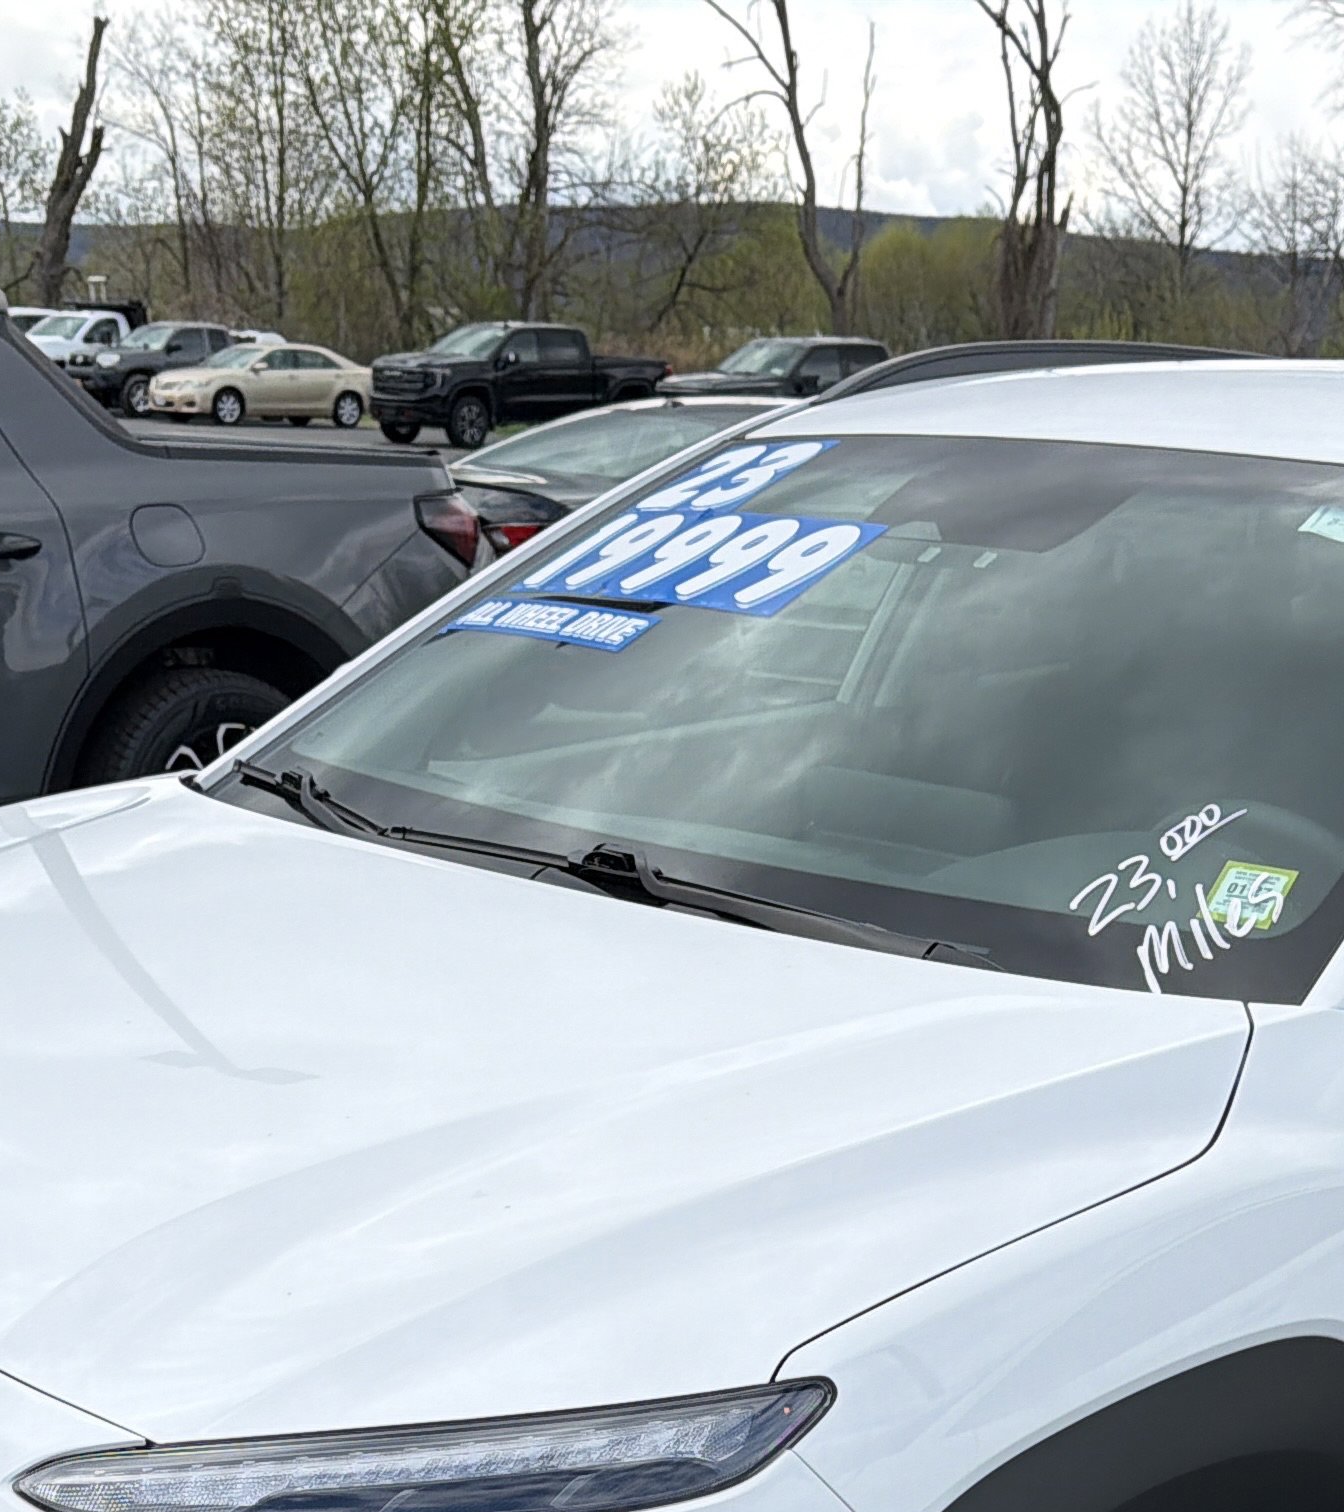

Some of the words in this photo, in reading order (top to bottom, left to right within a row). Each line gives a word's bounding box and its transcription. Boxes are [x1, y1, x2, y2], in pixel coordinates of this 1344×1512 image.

[637, 441, 823, 511] 23
[523, 513, 861, 609] 19999
[493, 603, 579, 634] WHEEL
[559, 611, 649, 646] DRIVE
